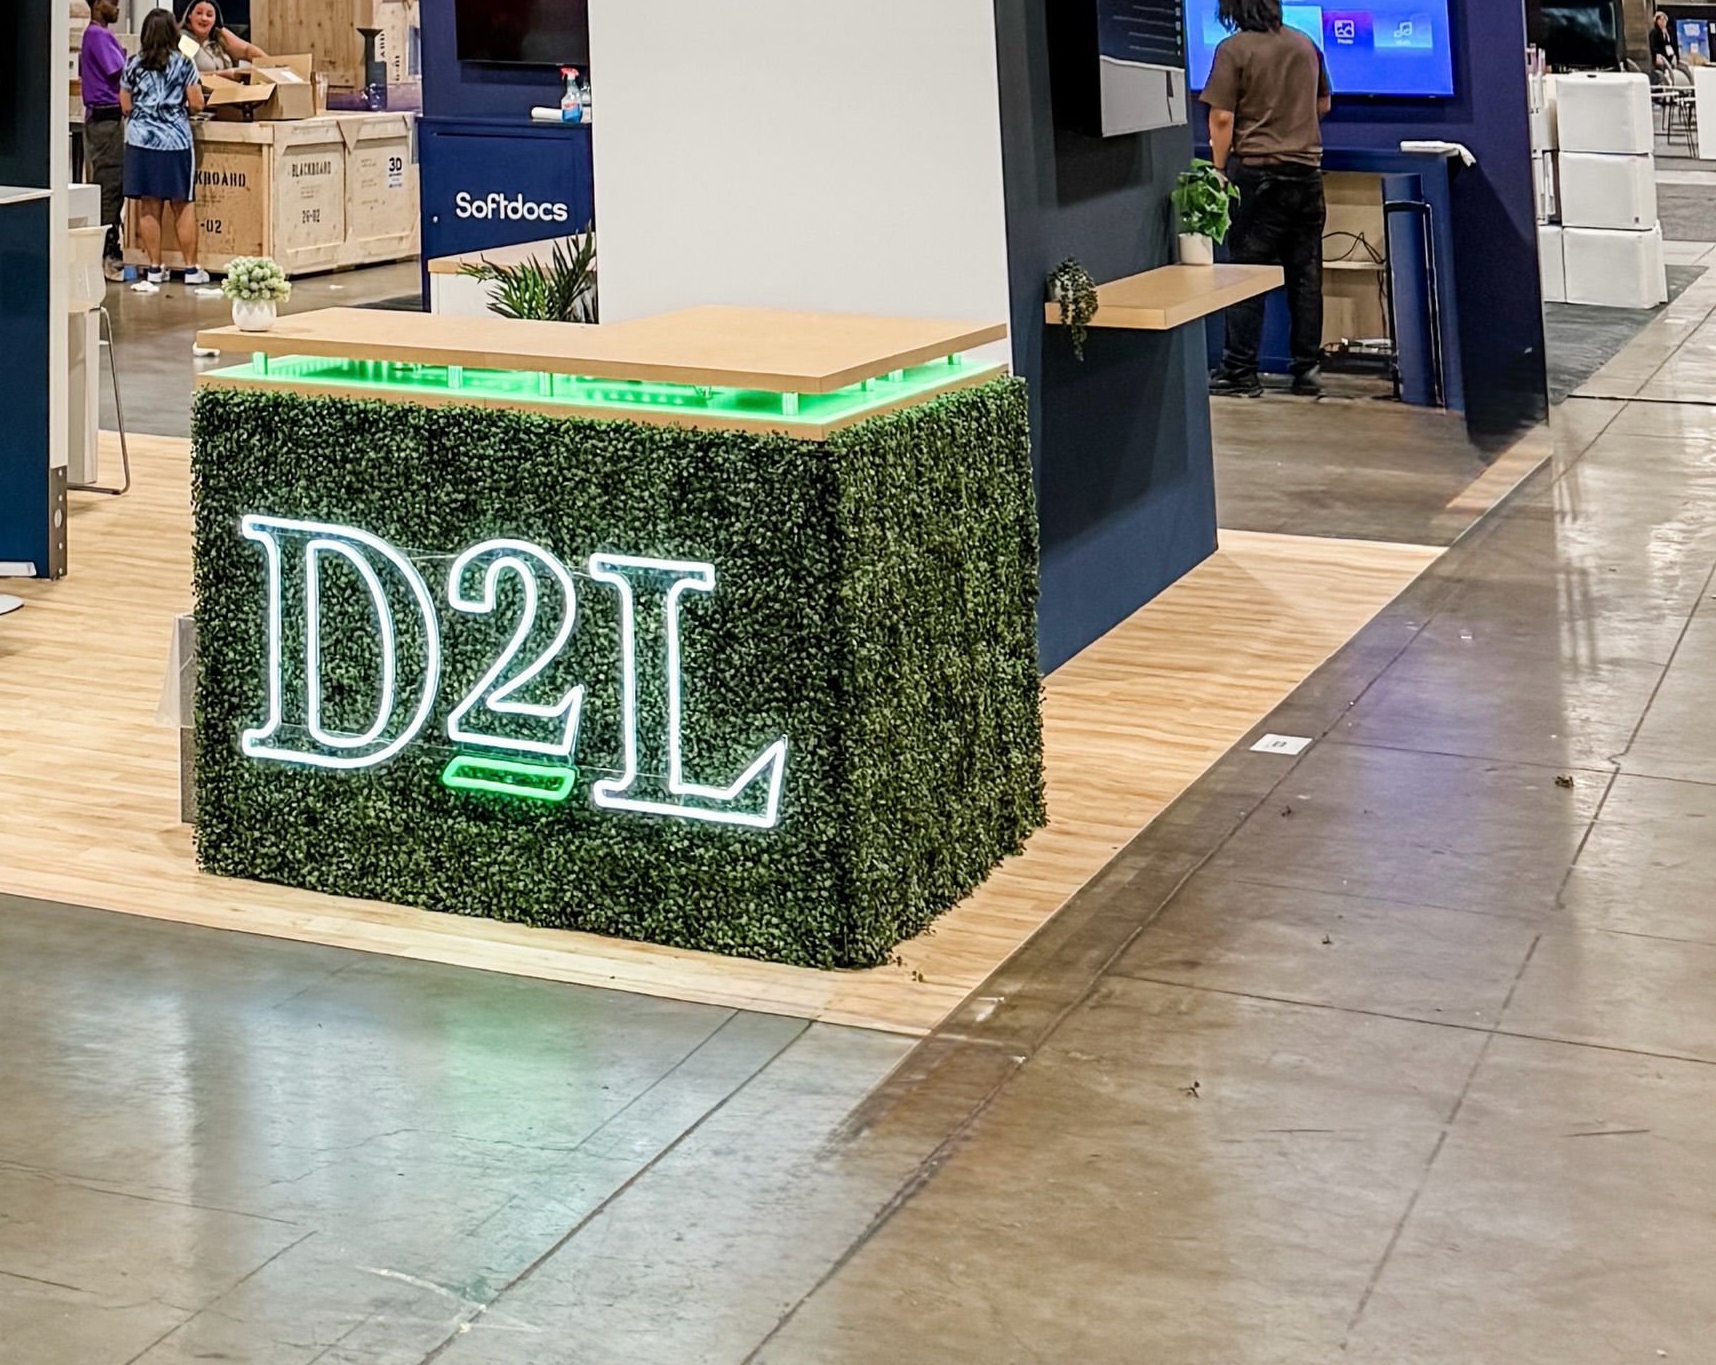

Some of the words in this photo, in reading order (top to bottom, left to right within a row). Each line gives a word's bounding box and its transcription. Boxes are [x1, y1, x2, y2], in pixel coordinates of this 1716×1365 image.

[292, 161, 331, 177] BLACKBOARD
[388, 157, 403, 172] 3D
[455, 191, 568, 222] Softdocs
[241, 513, 787, 828] D2L
